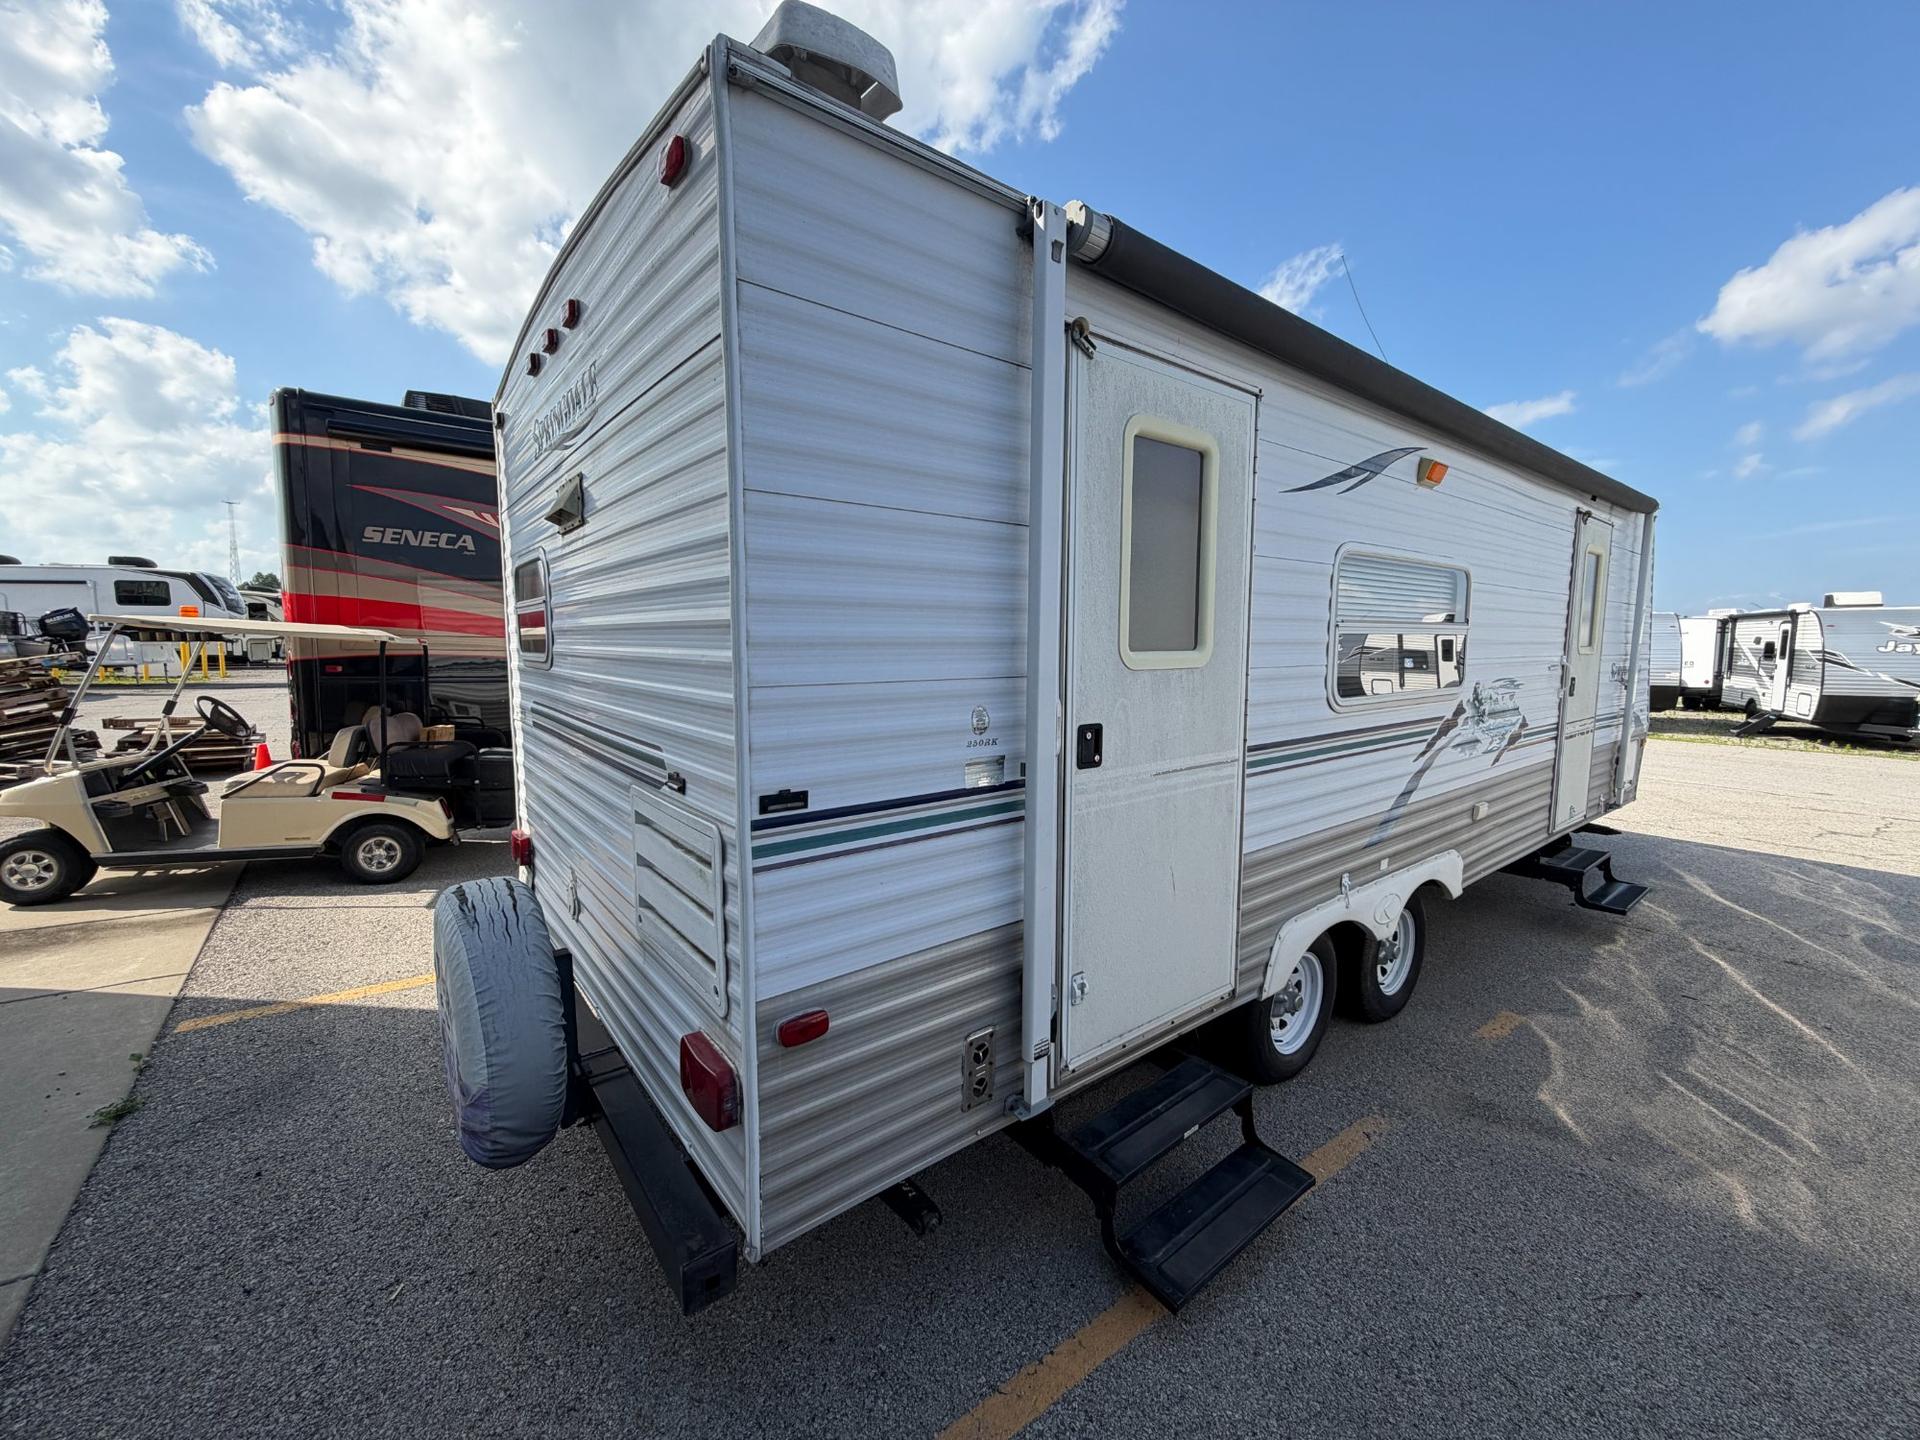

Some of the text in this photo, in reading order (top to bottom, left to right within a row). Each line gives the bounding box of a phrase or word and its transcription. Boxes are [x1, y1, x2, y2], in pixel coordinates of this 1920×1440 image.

[362, 526, 476, 551] SENECA
[45, 613, 75, 624] SUZUKI
[966, 738, 999, 748] 250RK
